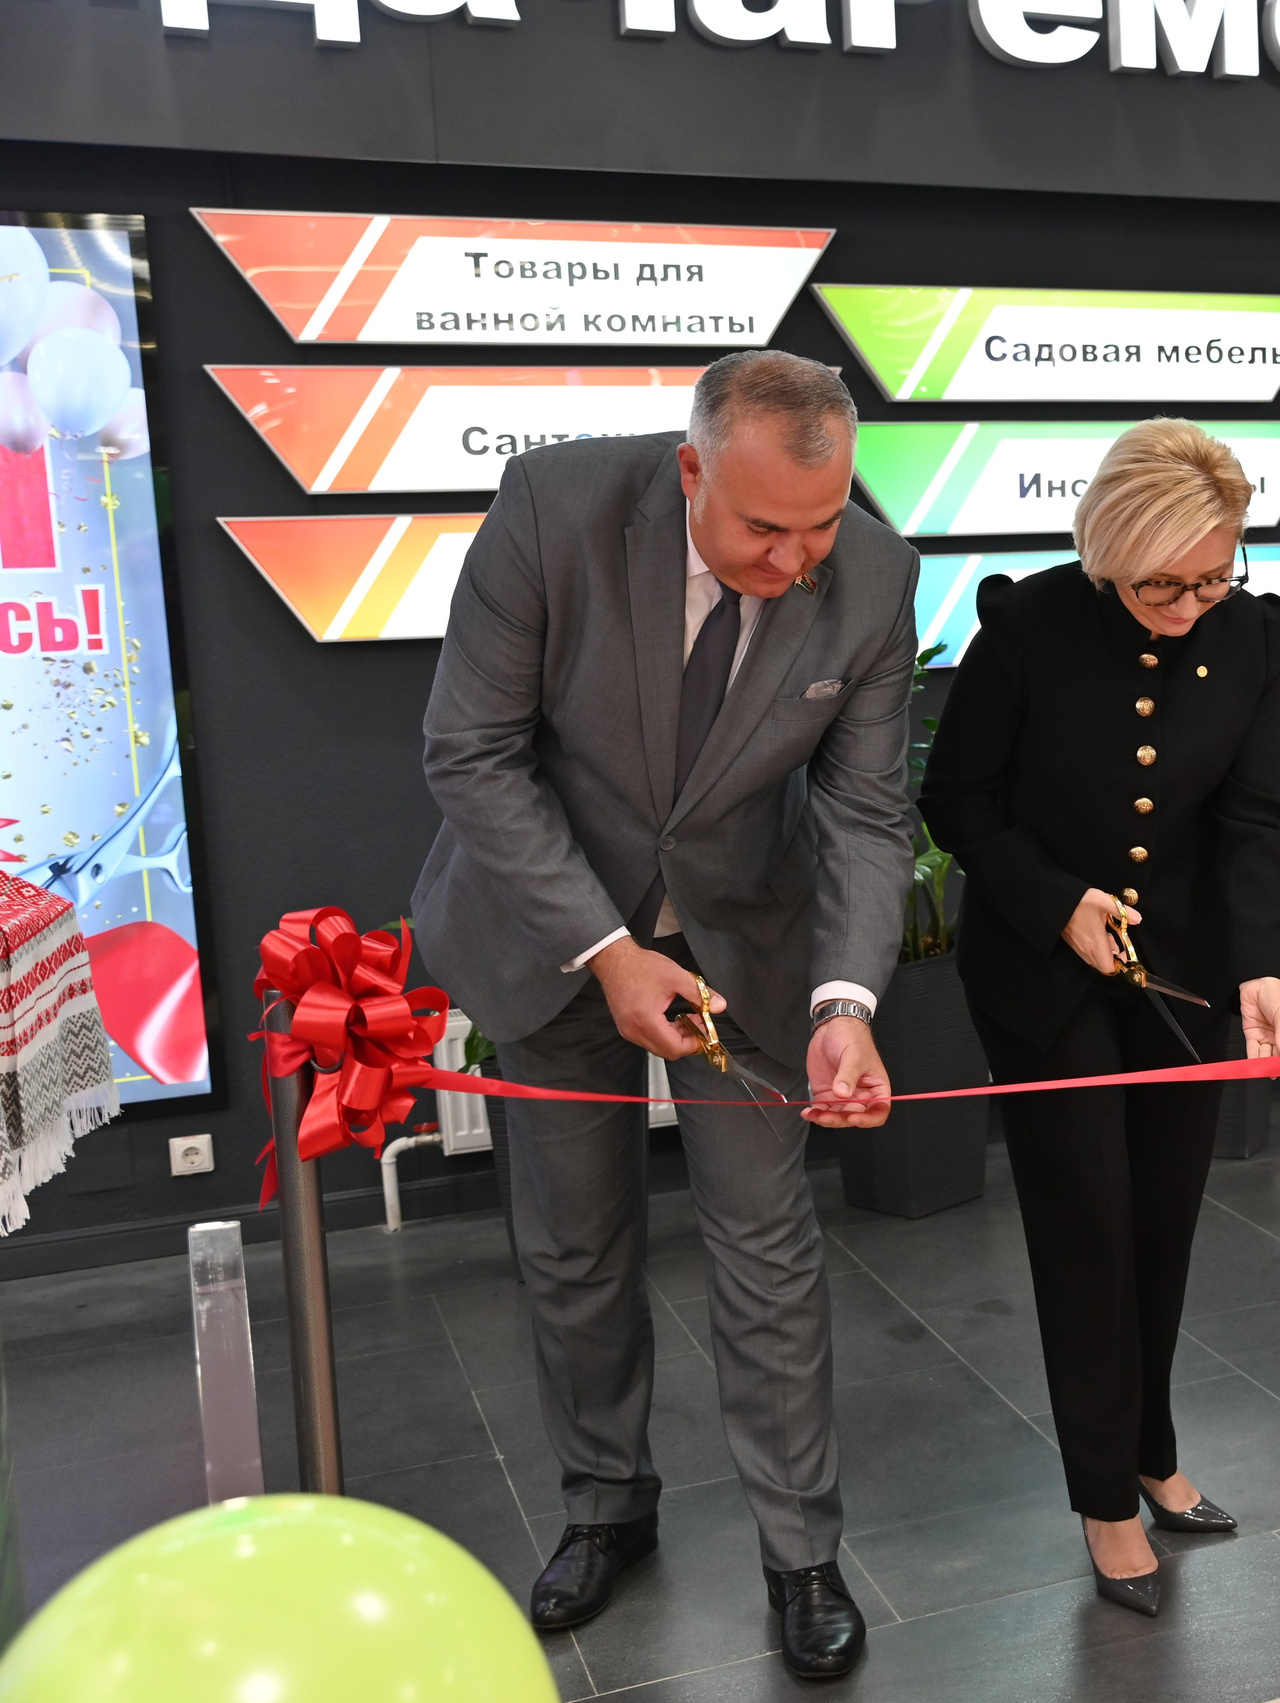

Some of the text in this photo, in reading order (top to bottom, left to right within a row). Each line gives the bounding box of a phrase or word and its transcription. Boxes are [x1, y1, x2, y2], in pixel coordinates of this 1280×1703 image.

[464, 252, 704, 287] Товары для
[415, 306, 755, 334] ванной комнаты
[984, 335, 1142, 367] Садовая
